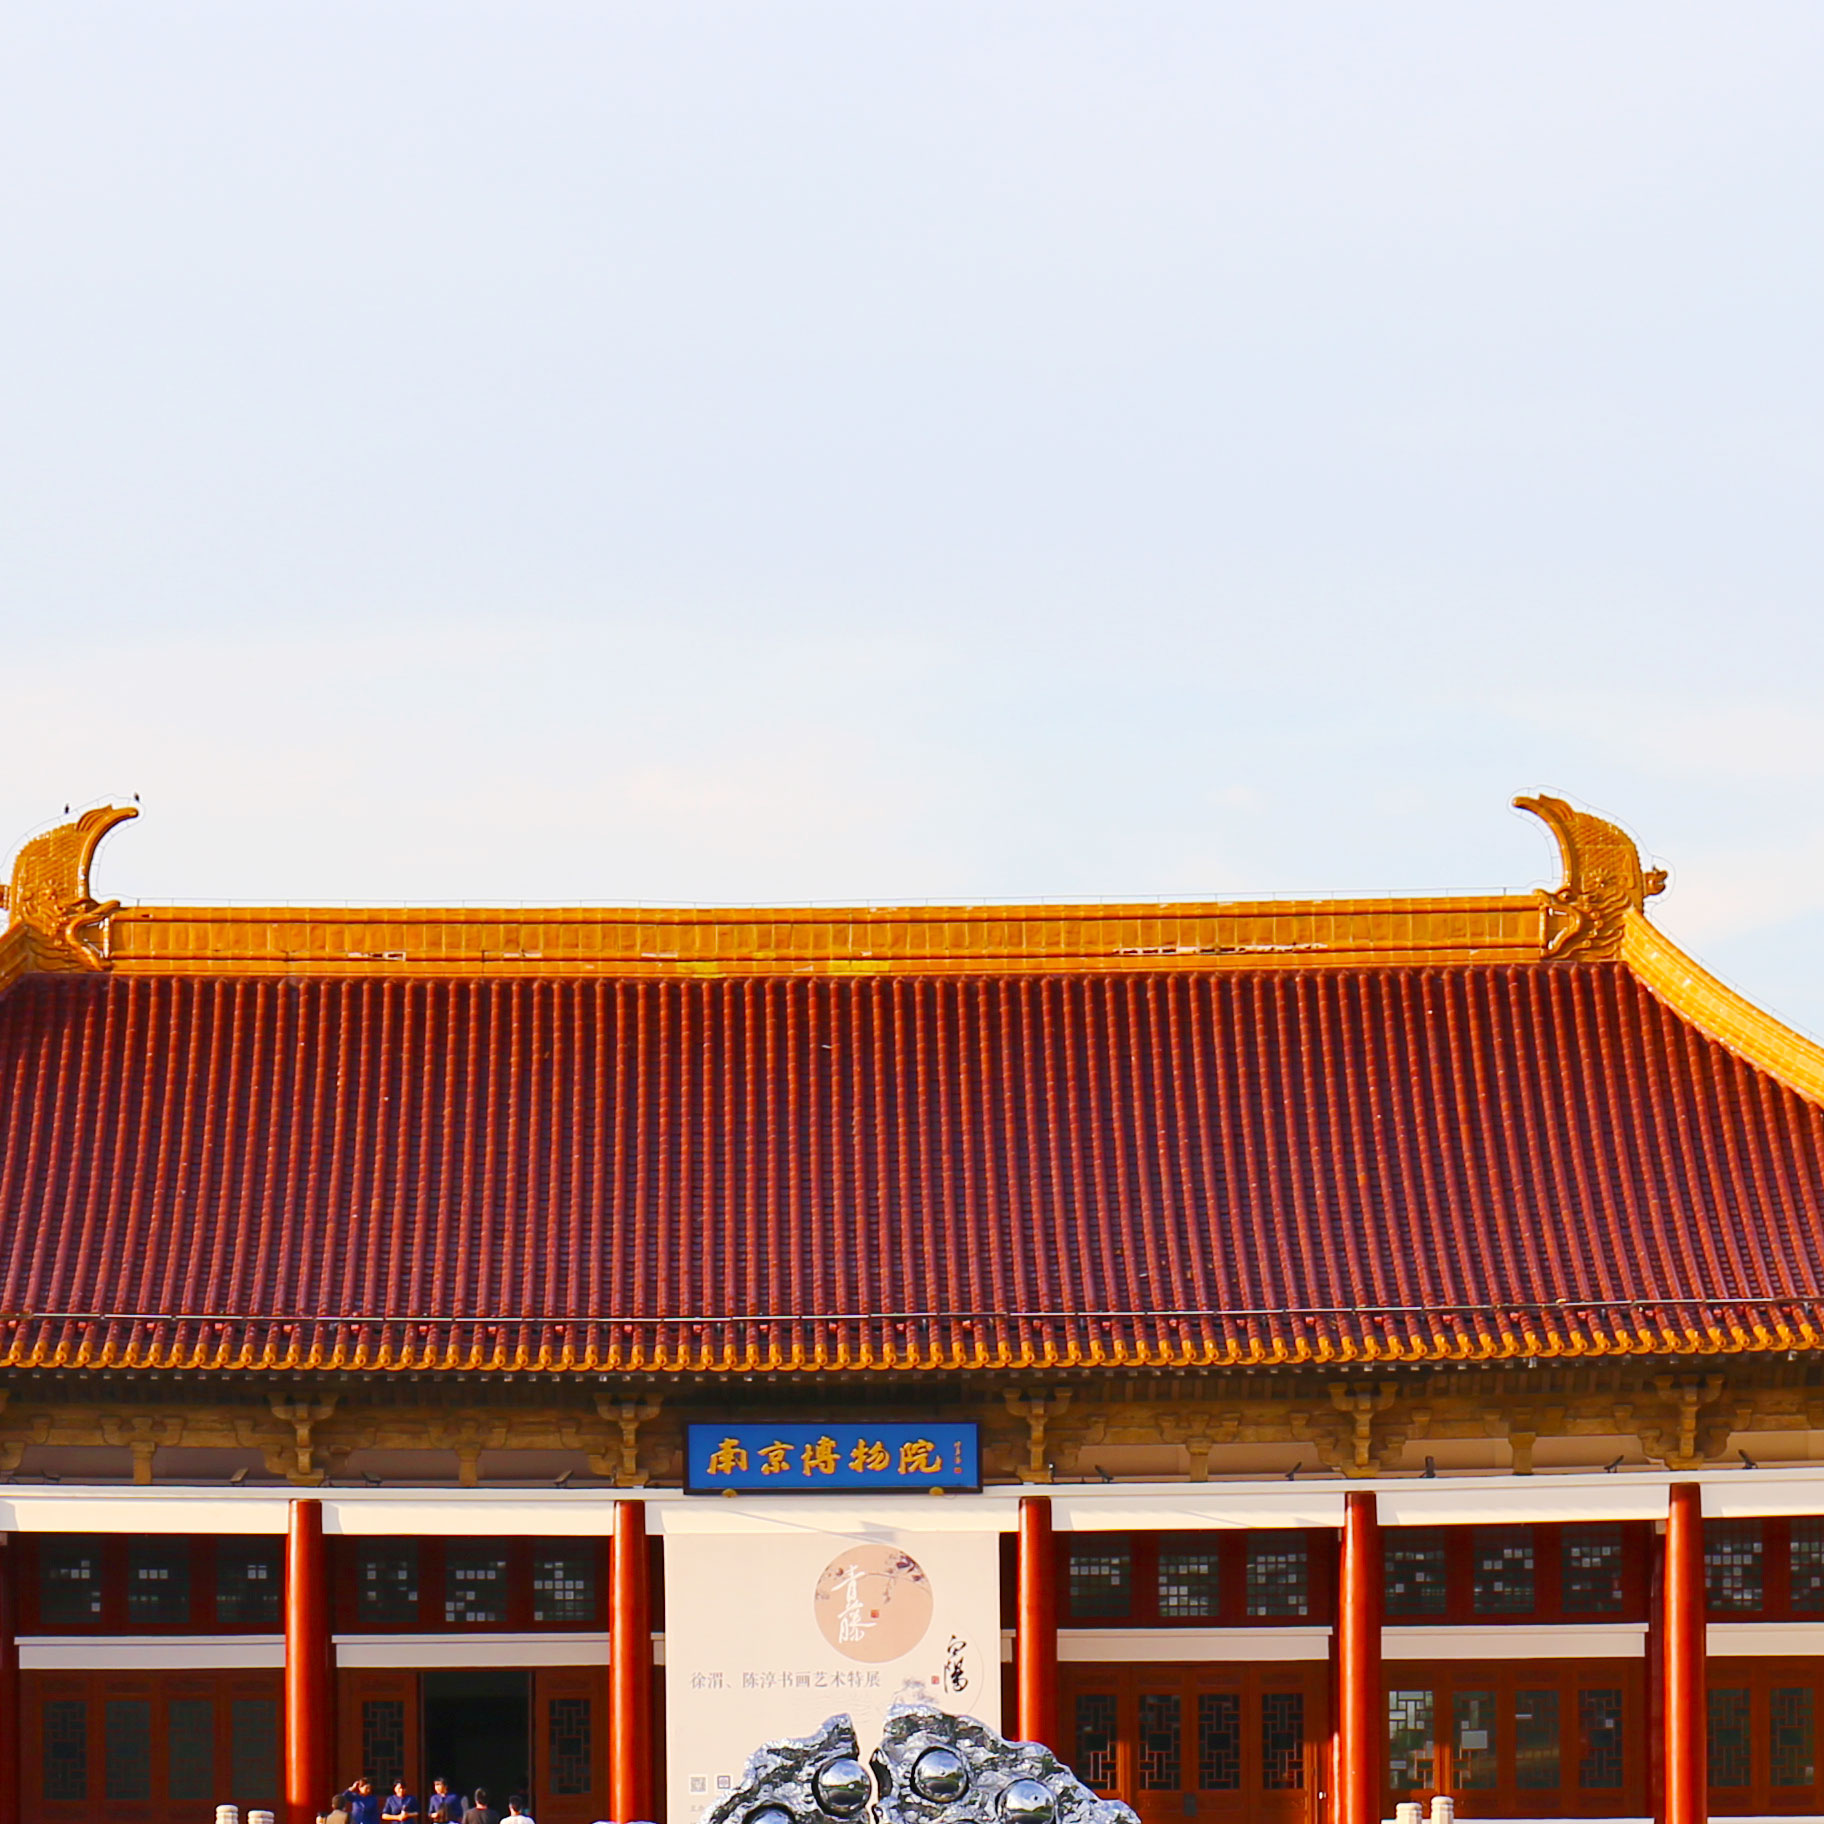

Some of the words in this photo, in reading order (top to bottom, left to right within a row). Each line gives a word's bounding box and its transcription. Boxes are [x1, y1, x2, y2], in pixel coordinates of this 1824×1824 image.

[706, 1436, 943, 1476] 南京博物院
[831, 1564, 877, 1644] 青藤
[690, 1671, 881, 1689] 徐渭、陈淳书画艺术特展
